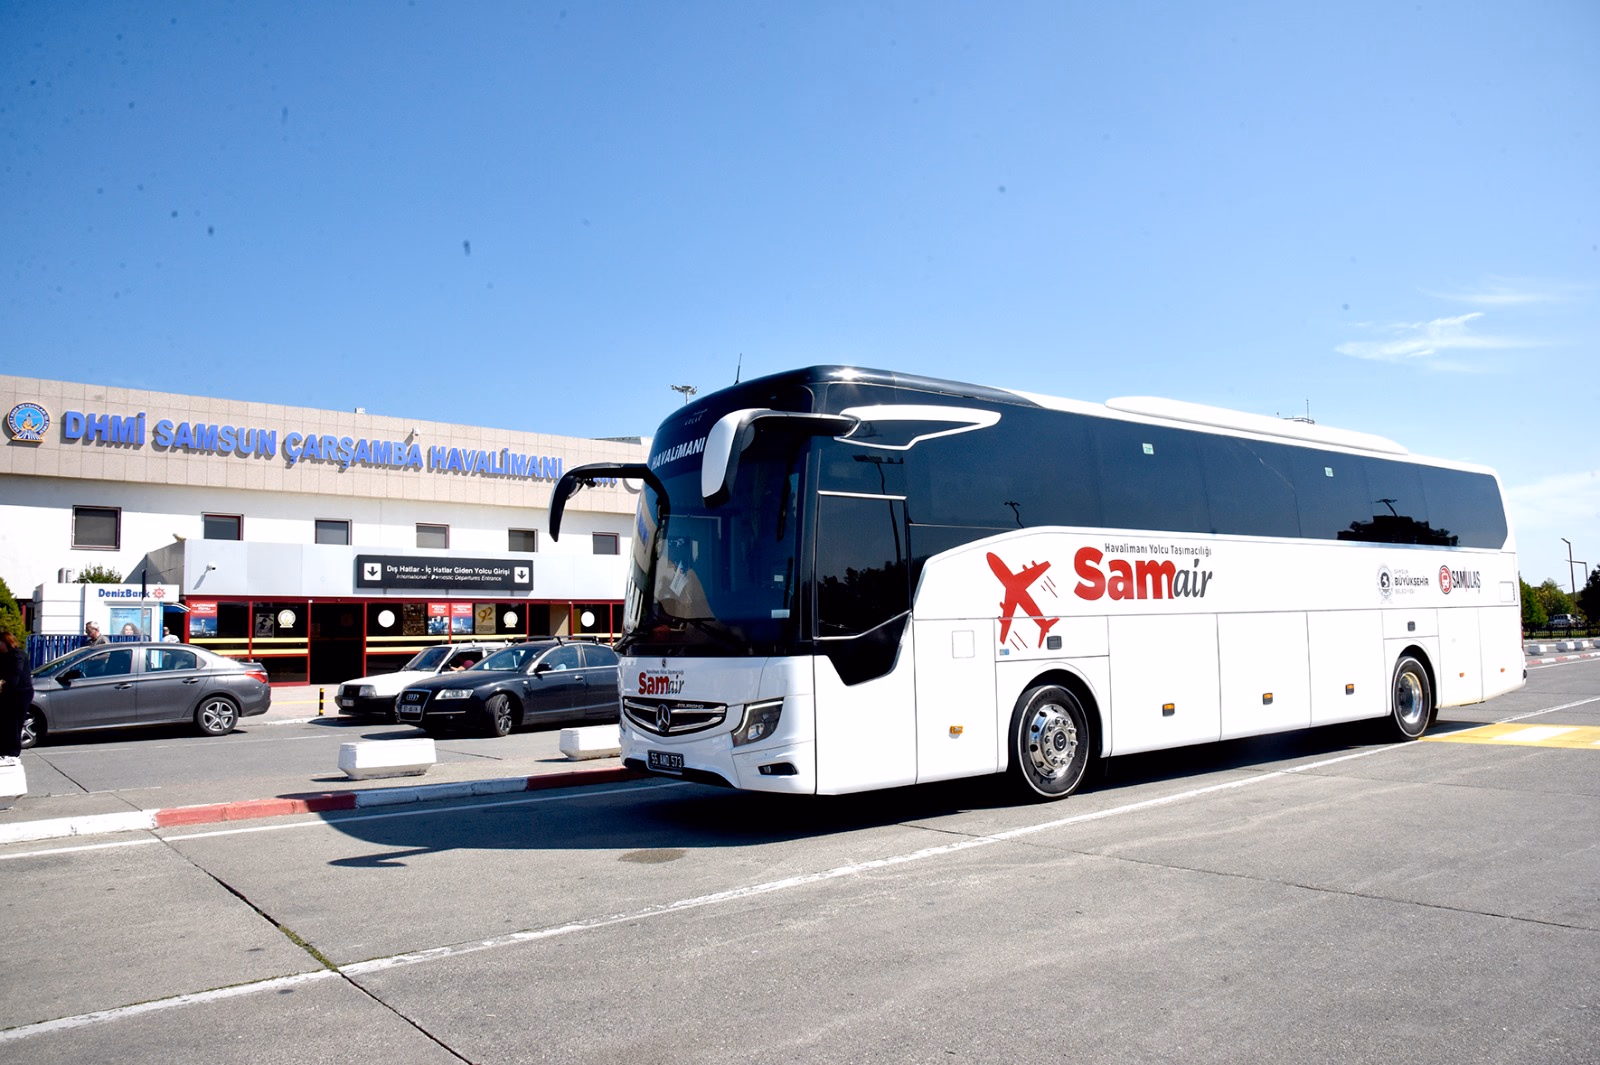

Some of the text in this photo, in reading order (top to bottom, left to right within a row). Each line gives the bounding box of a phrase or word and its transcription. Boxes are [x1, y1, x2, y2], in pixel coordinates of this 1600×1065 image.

[65, 411, 146, 445] DHMİ
[155, 419, 277, 456] SAMSUN
[285, 431, 424, 469] ÇARŞAMBA
[431, 445, 562, 479] HAVALİMANI
[1104, 543, 1212, 557] Havalimanı Yolcu Taşımacılığı
[399, 565, 420, 573] Hatlar
[433, 566, 453, 574] Hatlar
[1074, 546, 1213, 601] Samair
[638, 672, 685, 695] Samair
